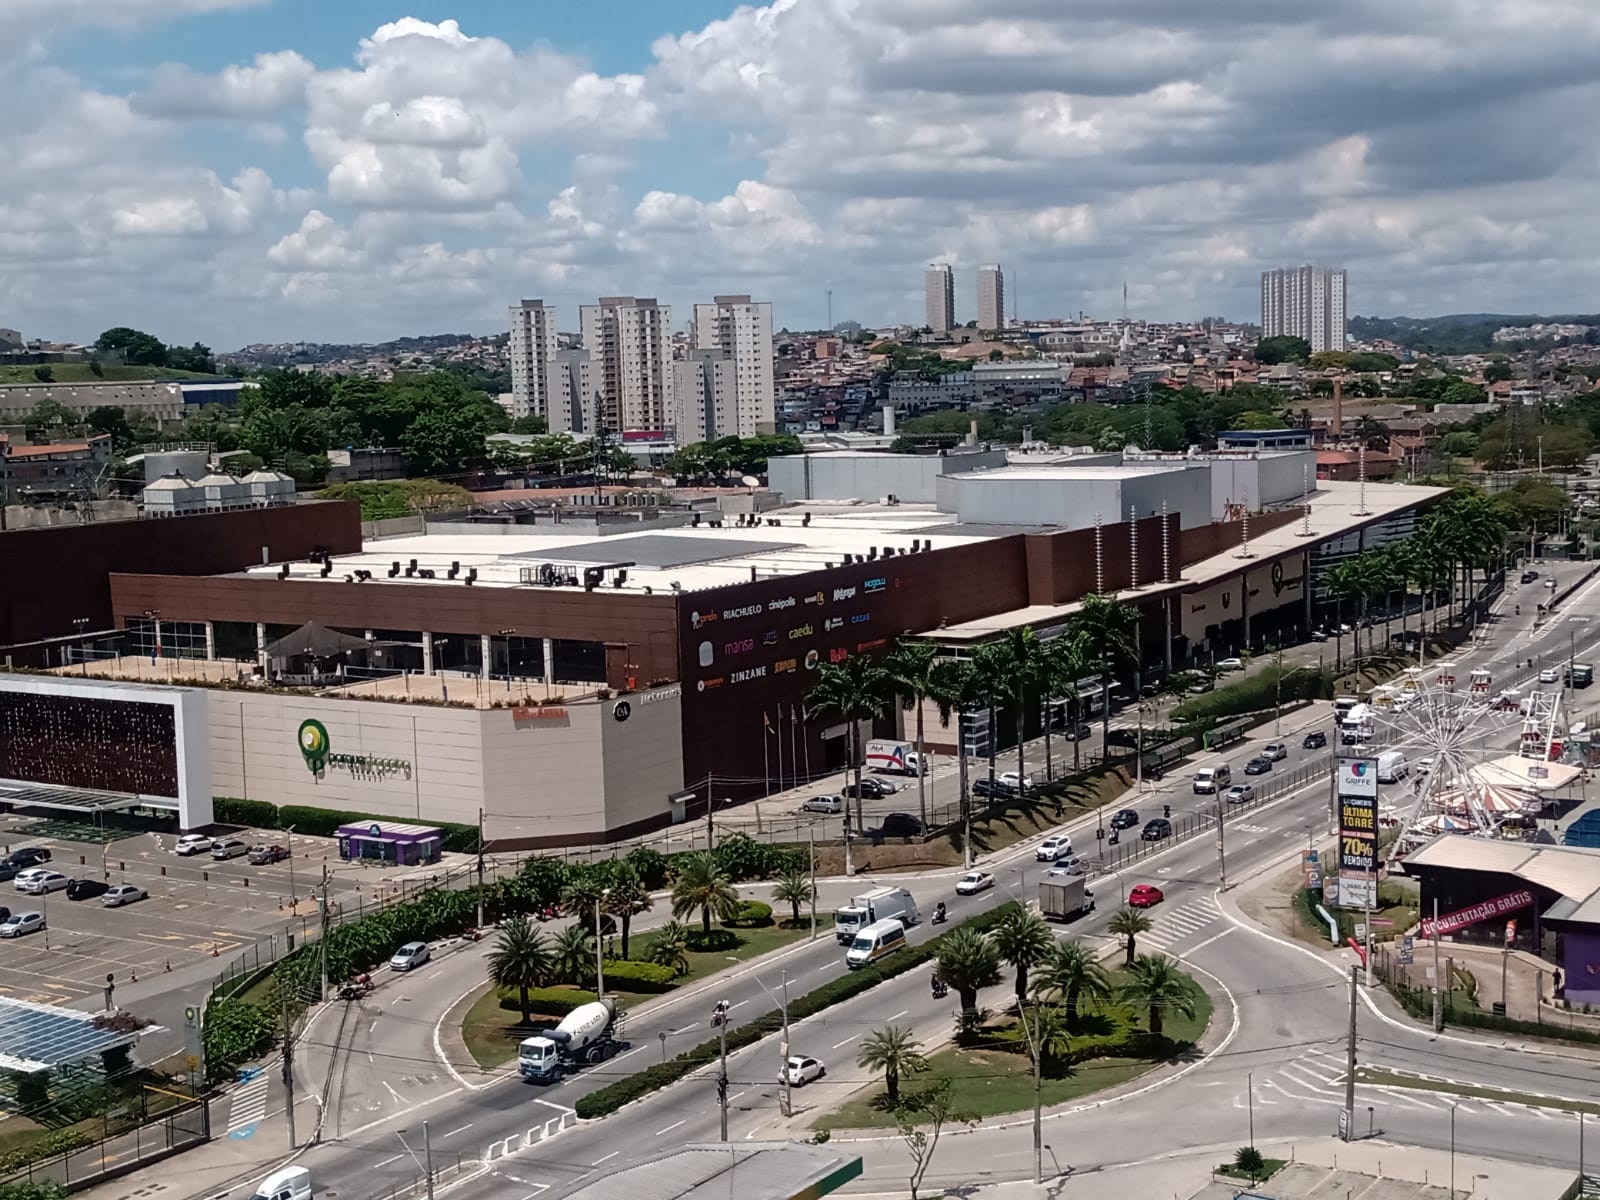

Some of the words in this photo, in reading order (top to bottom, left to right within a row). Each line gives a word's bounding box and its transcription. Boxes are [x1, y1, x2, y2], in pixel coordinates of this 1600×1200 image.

[723, 604, 762, 620] RIACHUELO
[788, 623, 814, 640] caedu
[724, 638, 754, 656] marisa
[730, 665, 767, 684] ZINZANE
[1345, 777, 1371, 786] GRIFFE
[1343, 805, 1373, 818] ÚLTIMA
[1343, 816, 1374, 829] TORRE
[1342, 837, 1373, 857] 70%
[1343, 855, 1373, 867] VENDIDO
[1423, 902, 1496, 935] DOCUMENTAÇÃO
[1497, 891, 1532, 911] GRÁTIS
